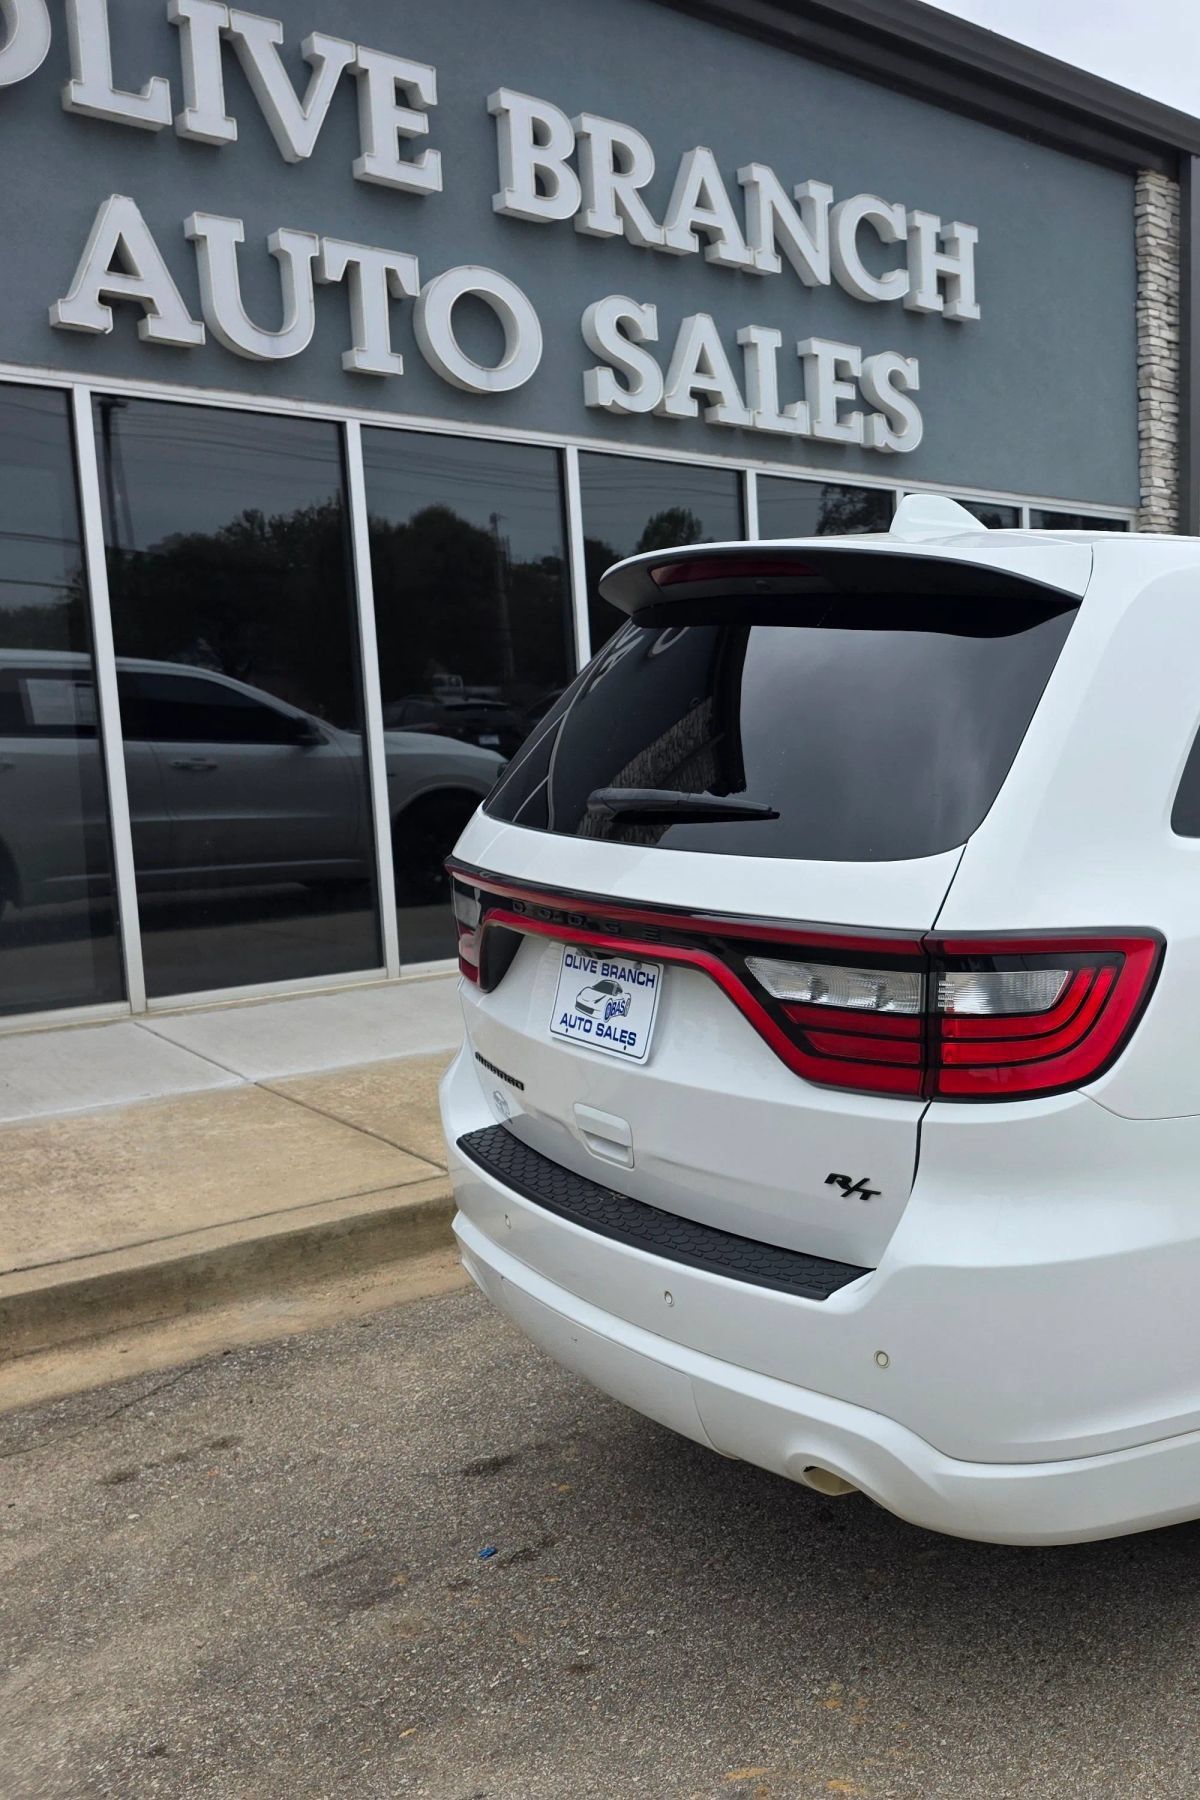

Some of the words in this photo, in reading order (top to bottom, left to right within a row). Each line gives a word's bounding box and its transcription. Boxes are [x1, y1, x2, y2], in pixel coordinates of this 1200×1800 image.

[0, 0, 442, 195] LIVE
[487, 87, 980, 321] BRANCH
[48, 193, 543, 394] AUTO
[584, 294, 924, 454] SALES
[564, 953, 598, 974] OLIVE
[600, 962, 656, 988] BRANCH
[560, 1012, 592, 1034] AUTO
[595, 1022, 637, 1046] SALES
[823, 1172, 882, 1201] R/T
